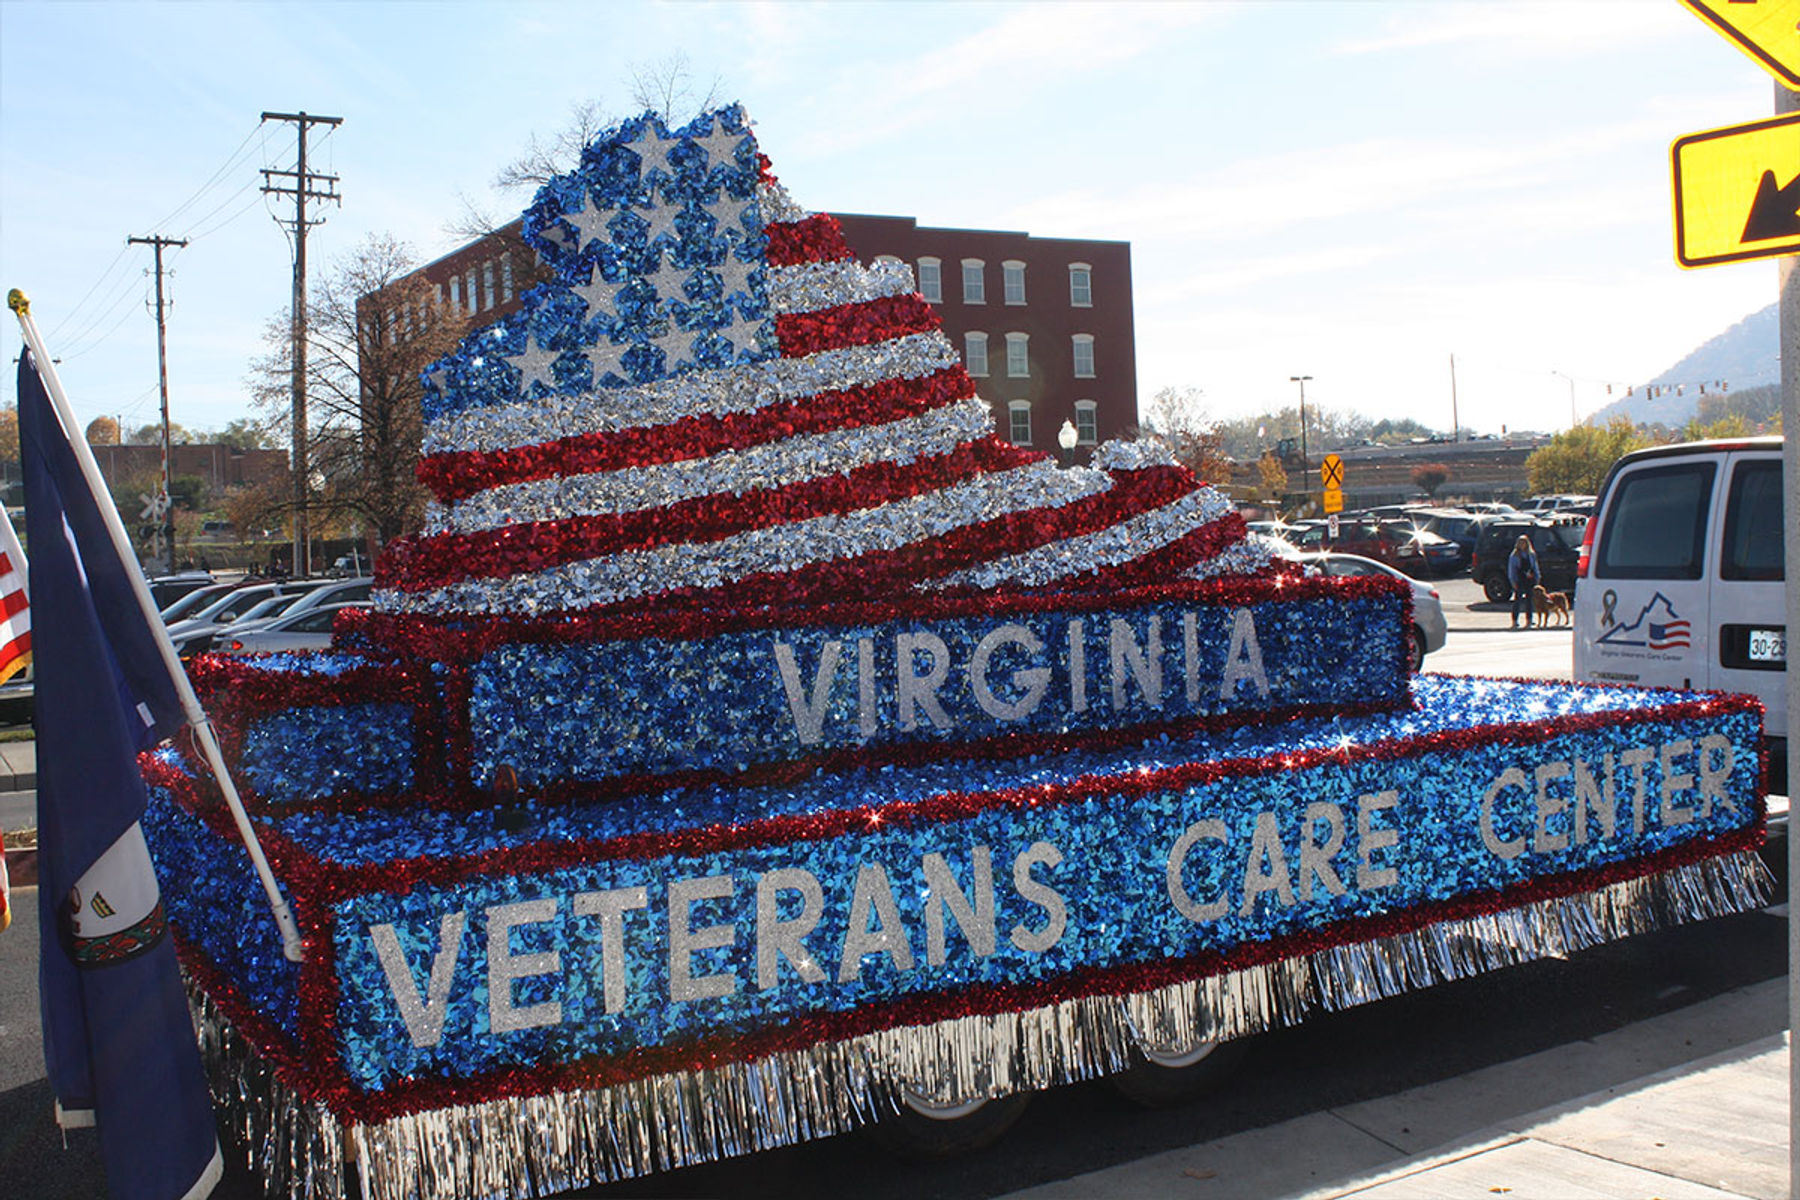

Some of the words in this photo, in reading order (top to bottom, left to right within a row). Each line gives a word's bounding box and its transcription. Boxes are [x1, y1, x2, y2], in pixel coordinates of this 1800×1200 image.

[773, 608, 1270, 745] VIRGINIA
[368, 841, 1068, 1049] VETERANS
[1166, 790, 1400, 923] CARE
[1480, 734, 1738, 860] CENTER
